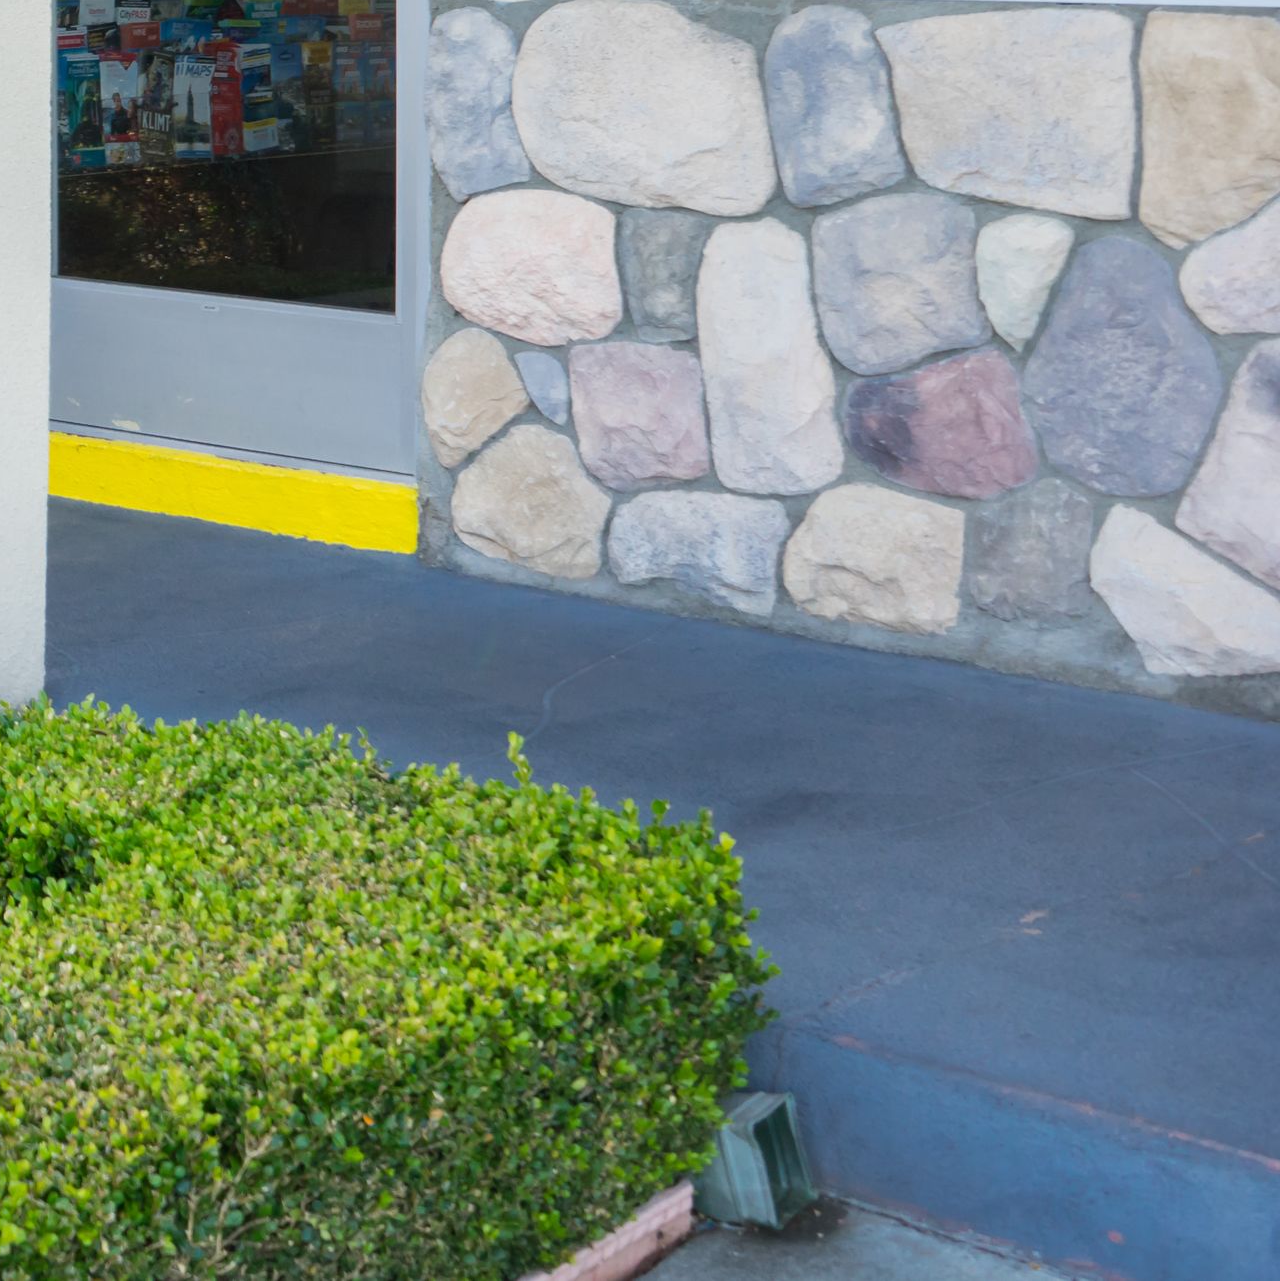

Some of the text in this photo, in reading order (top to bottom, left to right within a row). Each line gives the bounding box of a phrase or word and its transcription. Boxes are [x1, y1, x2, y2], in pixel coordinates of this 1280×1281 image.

[119, 9, 148, 21] CityPASS
[185, 64, 213, 78] MAPS
[142, 110, 171, 133] KLIMT
